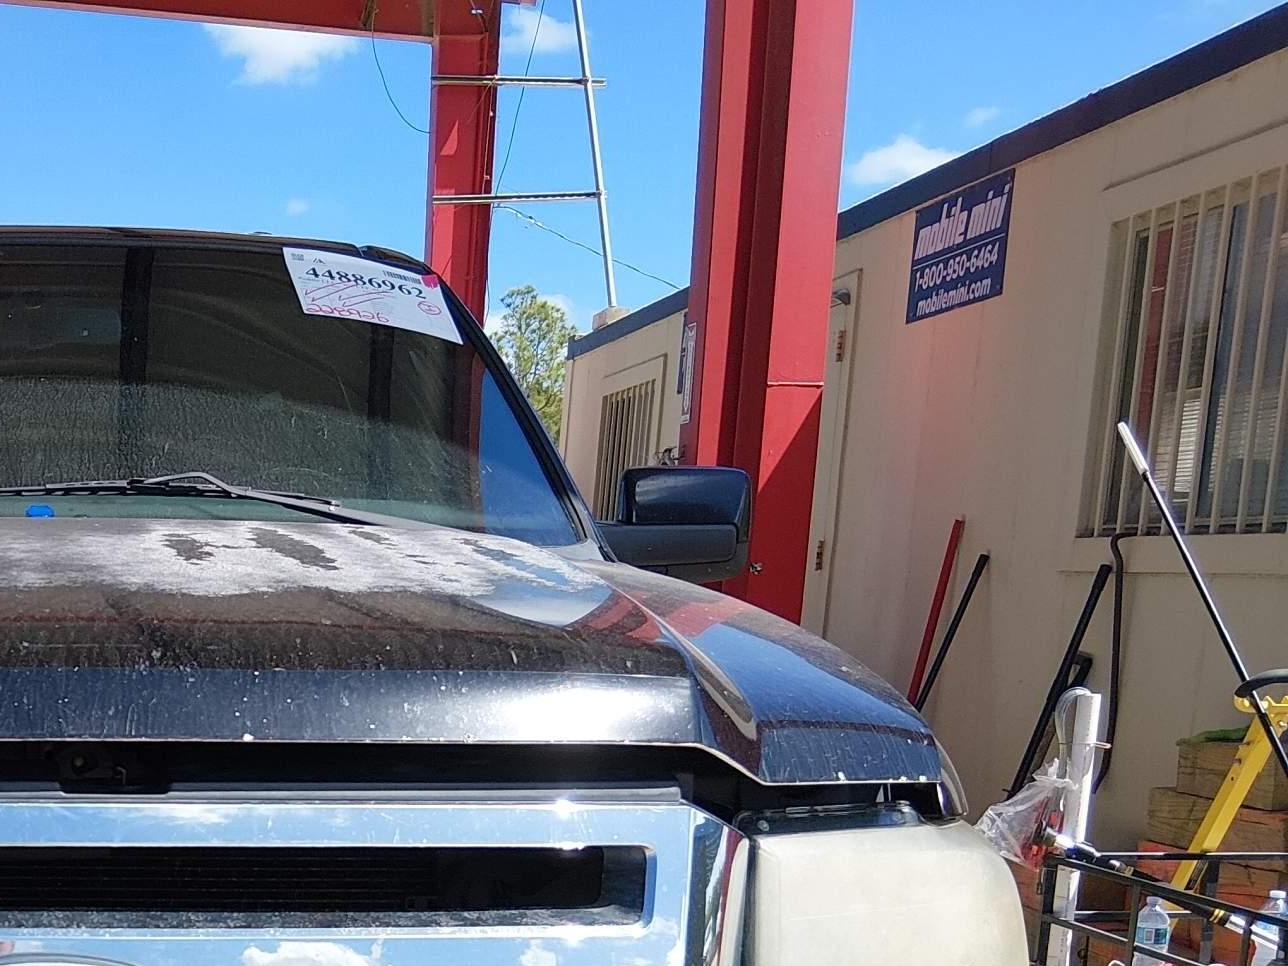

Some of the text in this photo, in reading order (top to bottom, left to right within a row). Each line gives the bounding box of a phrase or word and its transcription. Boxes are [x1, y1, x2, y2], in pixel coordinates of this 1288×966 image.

[914, 184, 1010, 260] mobile mini
[305, 266, 427, 300] 44886962
[915, 241, 1000, 293] 1-800-950-6464
[916, 277, 992, 317] mobilemini.com
